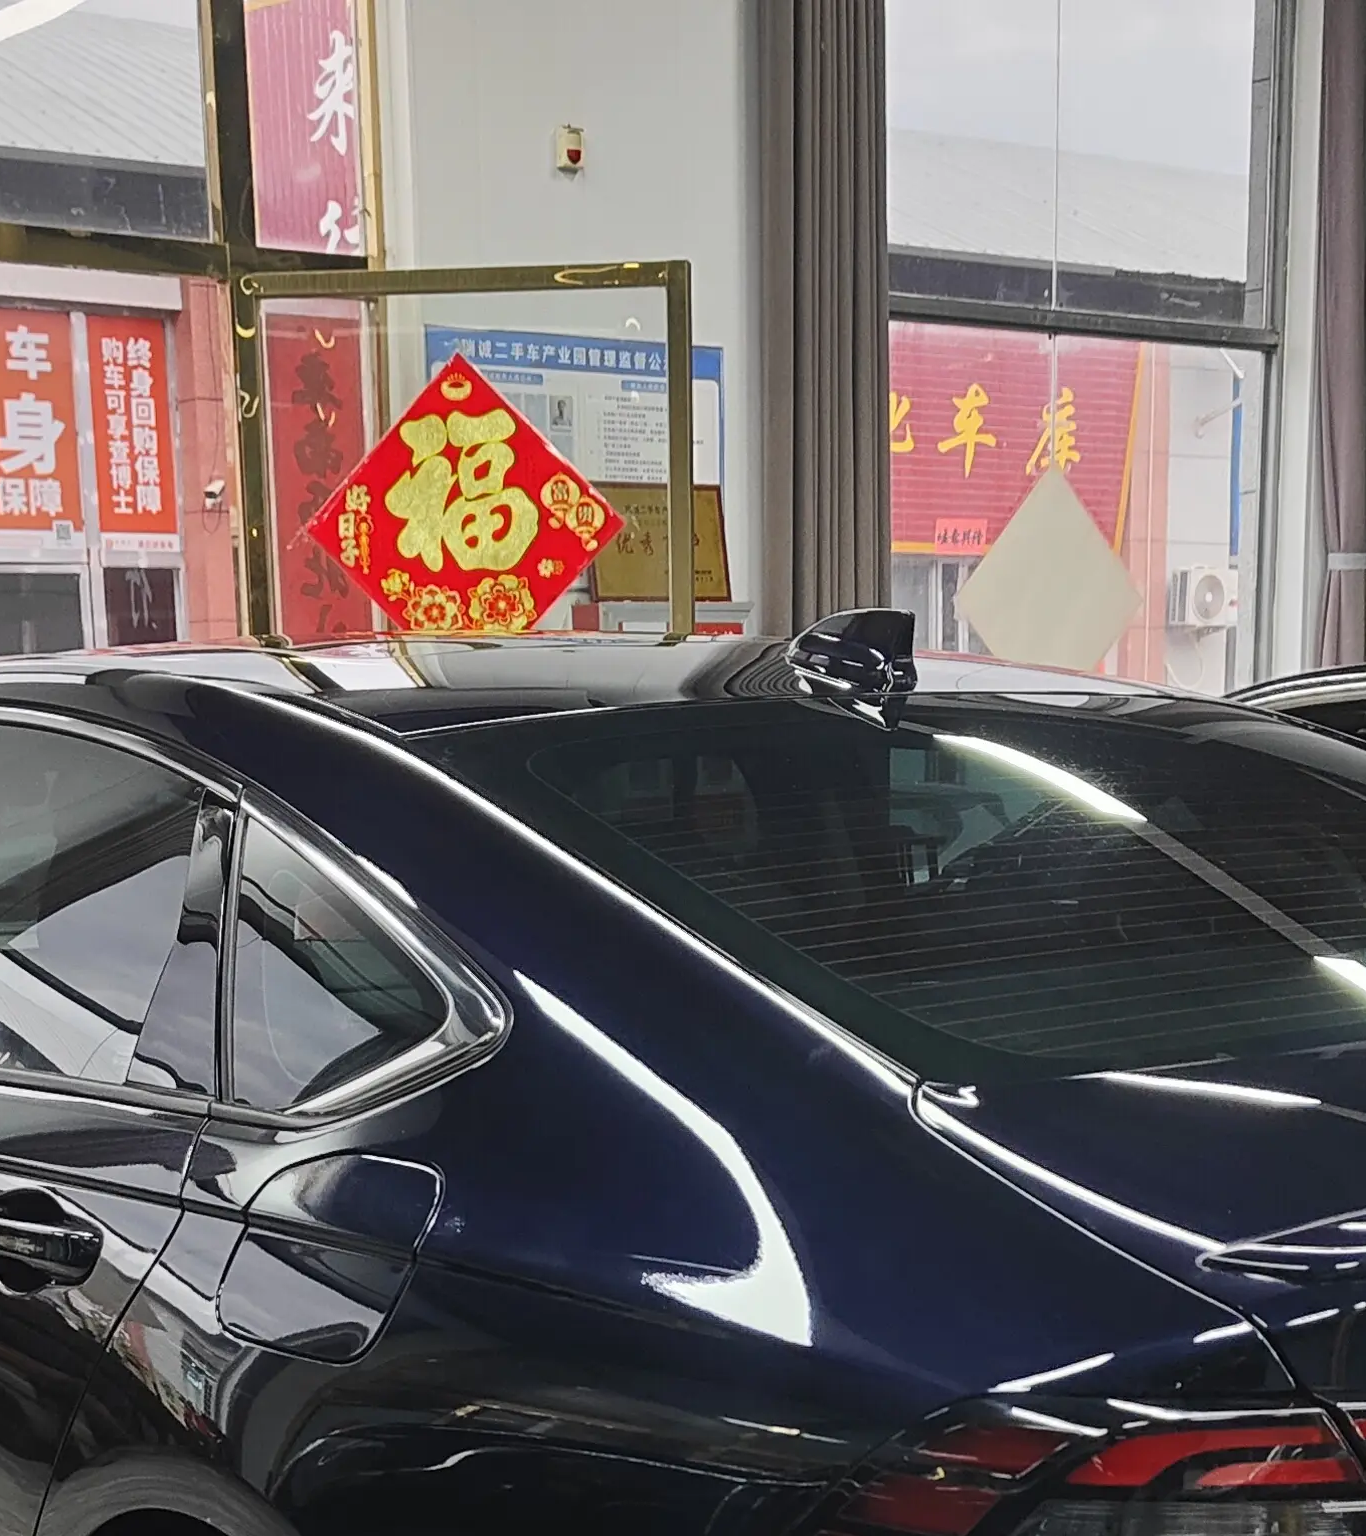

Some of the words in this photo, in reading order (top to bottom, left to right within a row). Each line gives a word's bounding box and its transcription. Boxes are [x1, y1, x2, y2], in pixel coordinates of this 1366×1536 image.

[101, 337, 134, 514] 购车可享查博士
[127, 337, 163, 514] 终身回购保障
[385, 408, 539, 572] 福
[338, 484, 371, 568] 好日子
